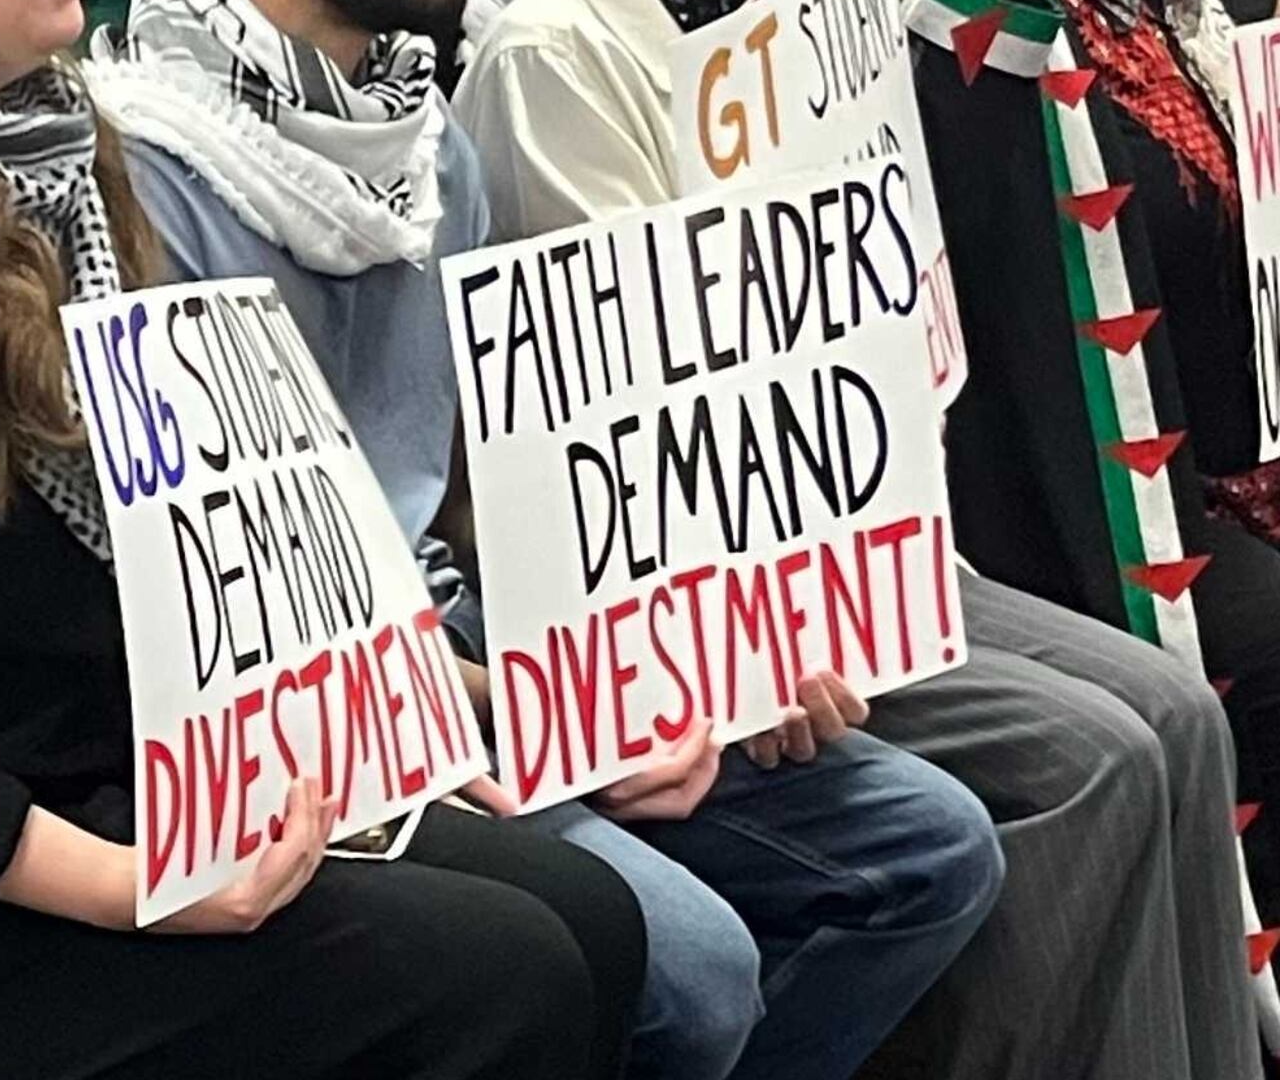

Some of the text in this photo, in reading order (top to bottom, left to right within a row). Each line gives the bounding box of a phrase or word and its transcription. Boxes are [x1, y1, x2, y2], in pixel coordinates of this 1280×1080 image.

[698, 11, 780, 180] GT
[74, 302, 185, 506] USG
[459, 231, 632, 443] FAITH
[645, 163, 918, 387] LEADERS
[167, 462, 374, 692] DEMAND
[567, 365, 887, 596] DEMAND
[143, 608, 471, 898] DIVESTMENT
[500, 516, 955, 805] DIVESTMENT!
